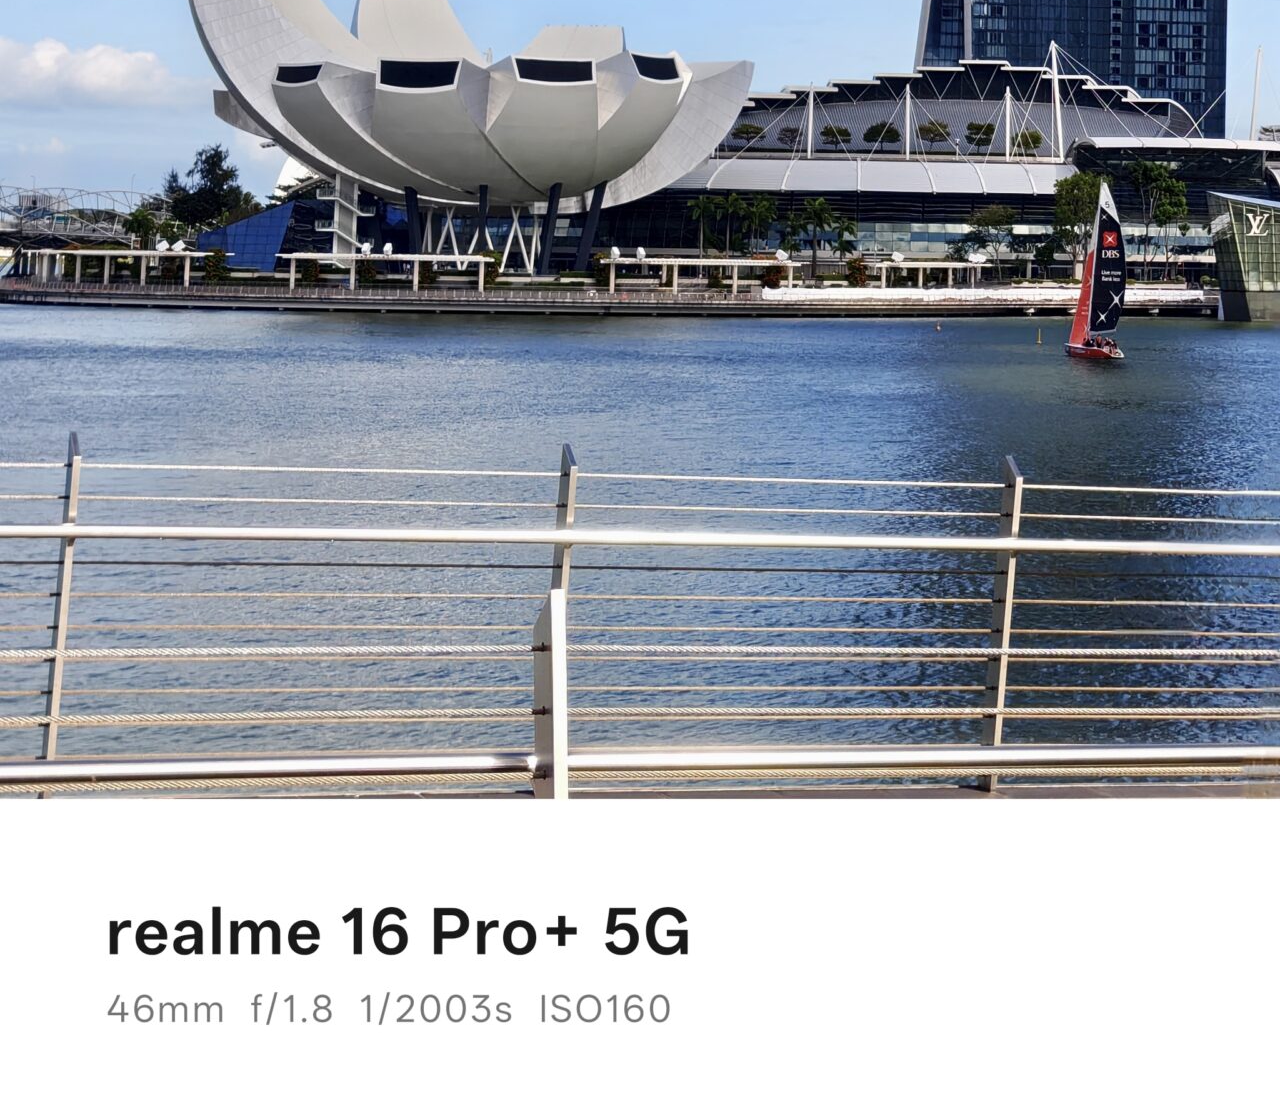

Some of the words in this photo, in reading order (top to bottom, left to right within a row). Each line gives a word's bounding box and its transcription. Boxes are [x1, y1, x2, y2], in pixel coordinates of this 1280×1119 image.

[1104, 201, 1110, 209] 5
[1246, 213, 1270, 237] LV
[1102, 249, 1120, 259] DBS
